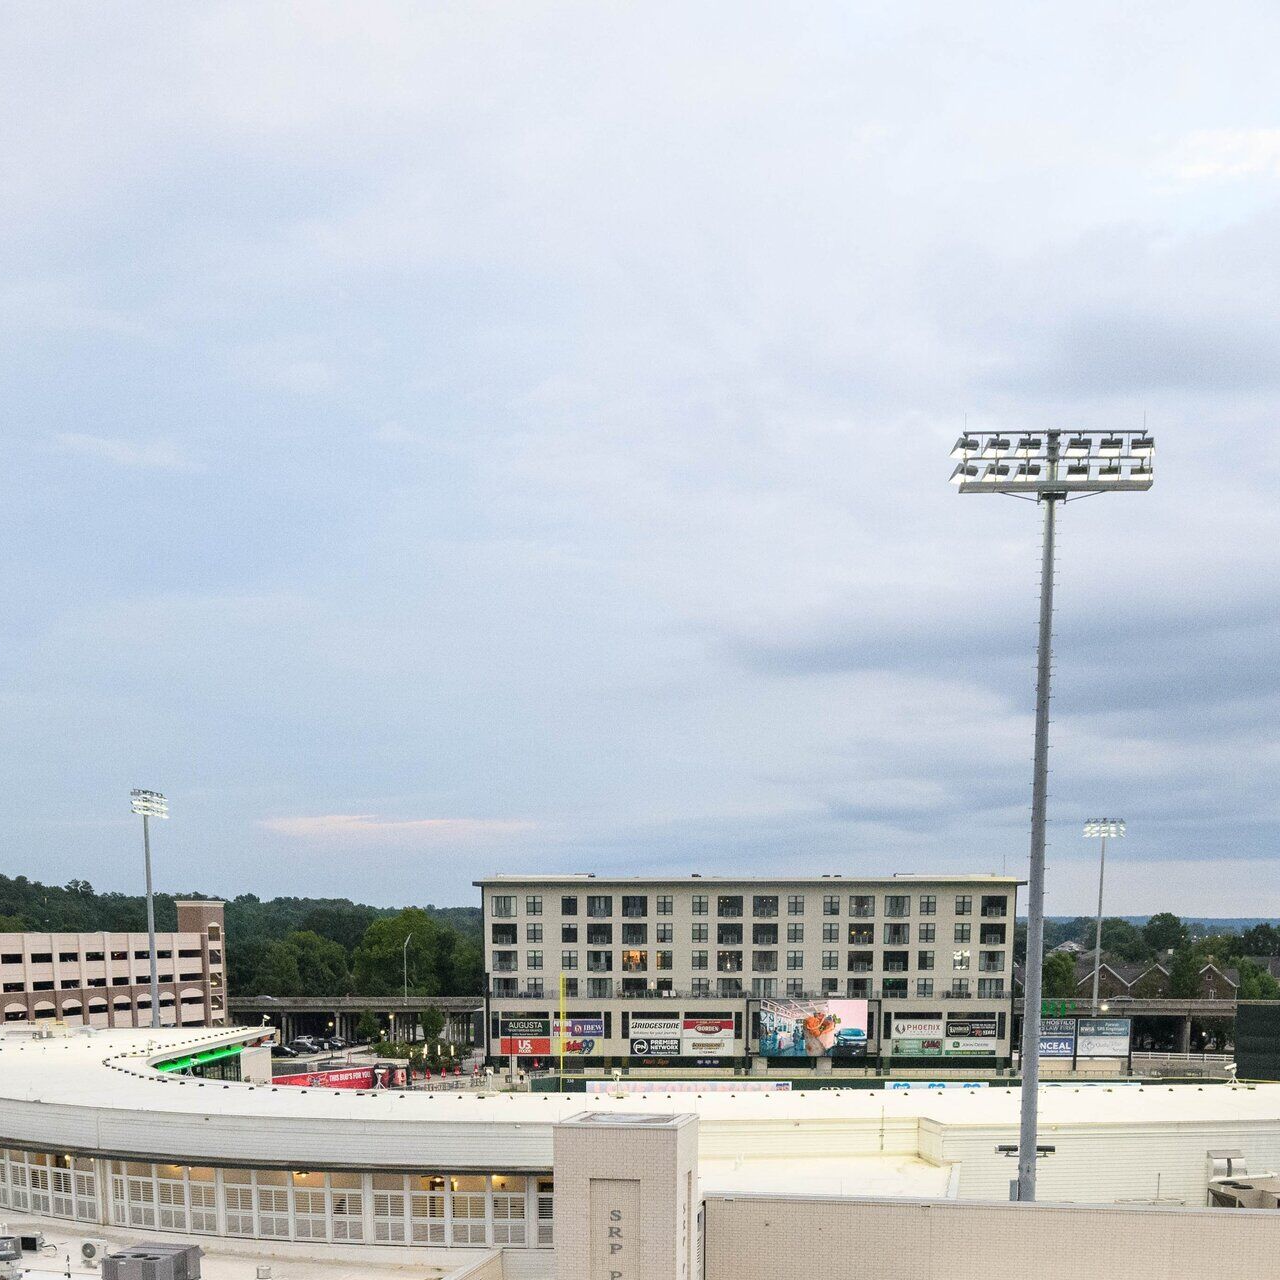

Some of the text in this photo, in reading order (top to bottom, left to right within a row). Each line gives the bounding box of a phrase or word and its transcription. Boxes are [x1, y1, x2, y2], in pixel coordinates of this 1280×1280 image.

[508, 1021, 543, 1029] AUGUSTA
[631, 1021, 680, 1029] BRIDGESTONE
[1039, 1042, 1071, 1050] NCEAL
[340, 1073, 352, 1082] BUD'S
[352, 1072, 362, 1080] FOR
[607, 1209, 624, 1255] SRP
